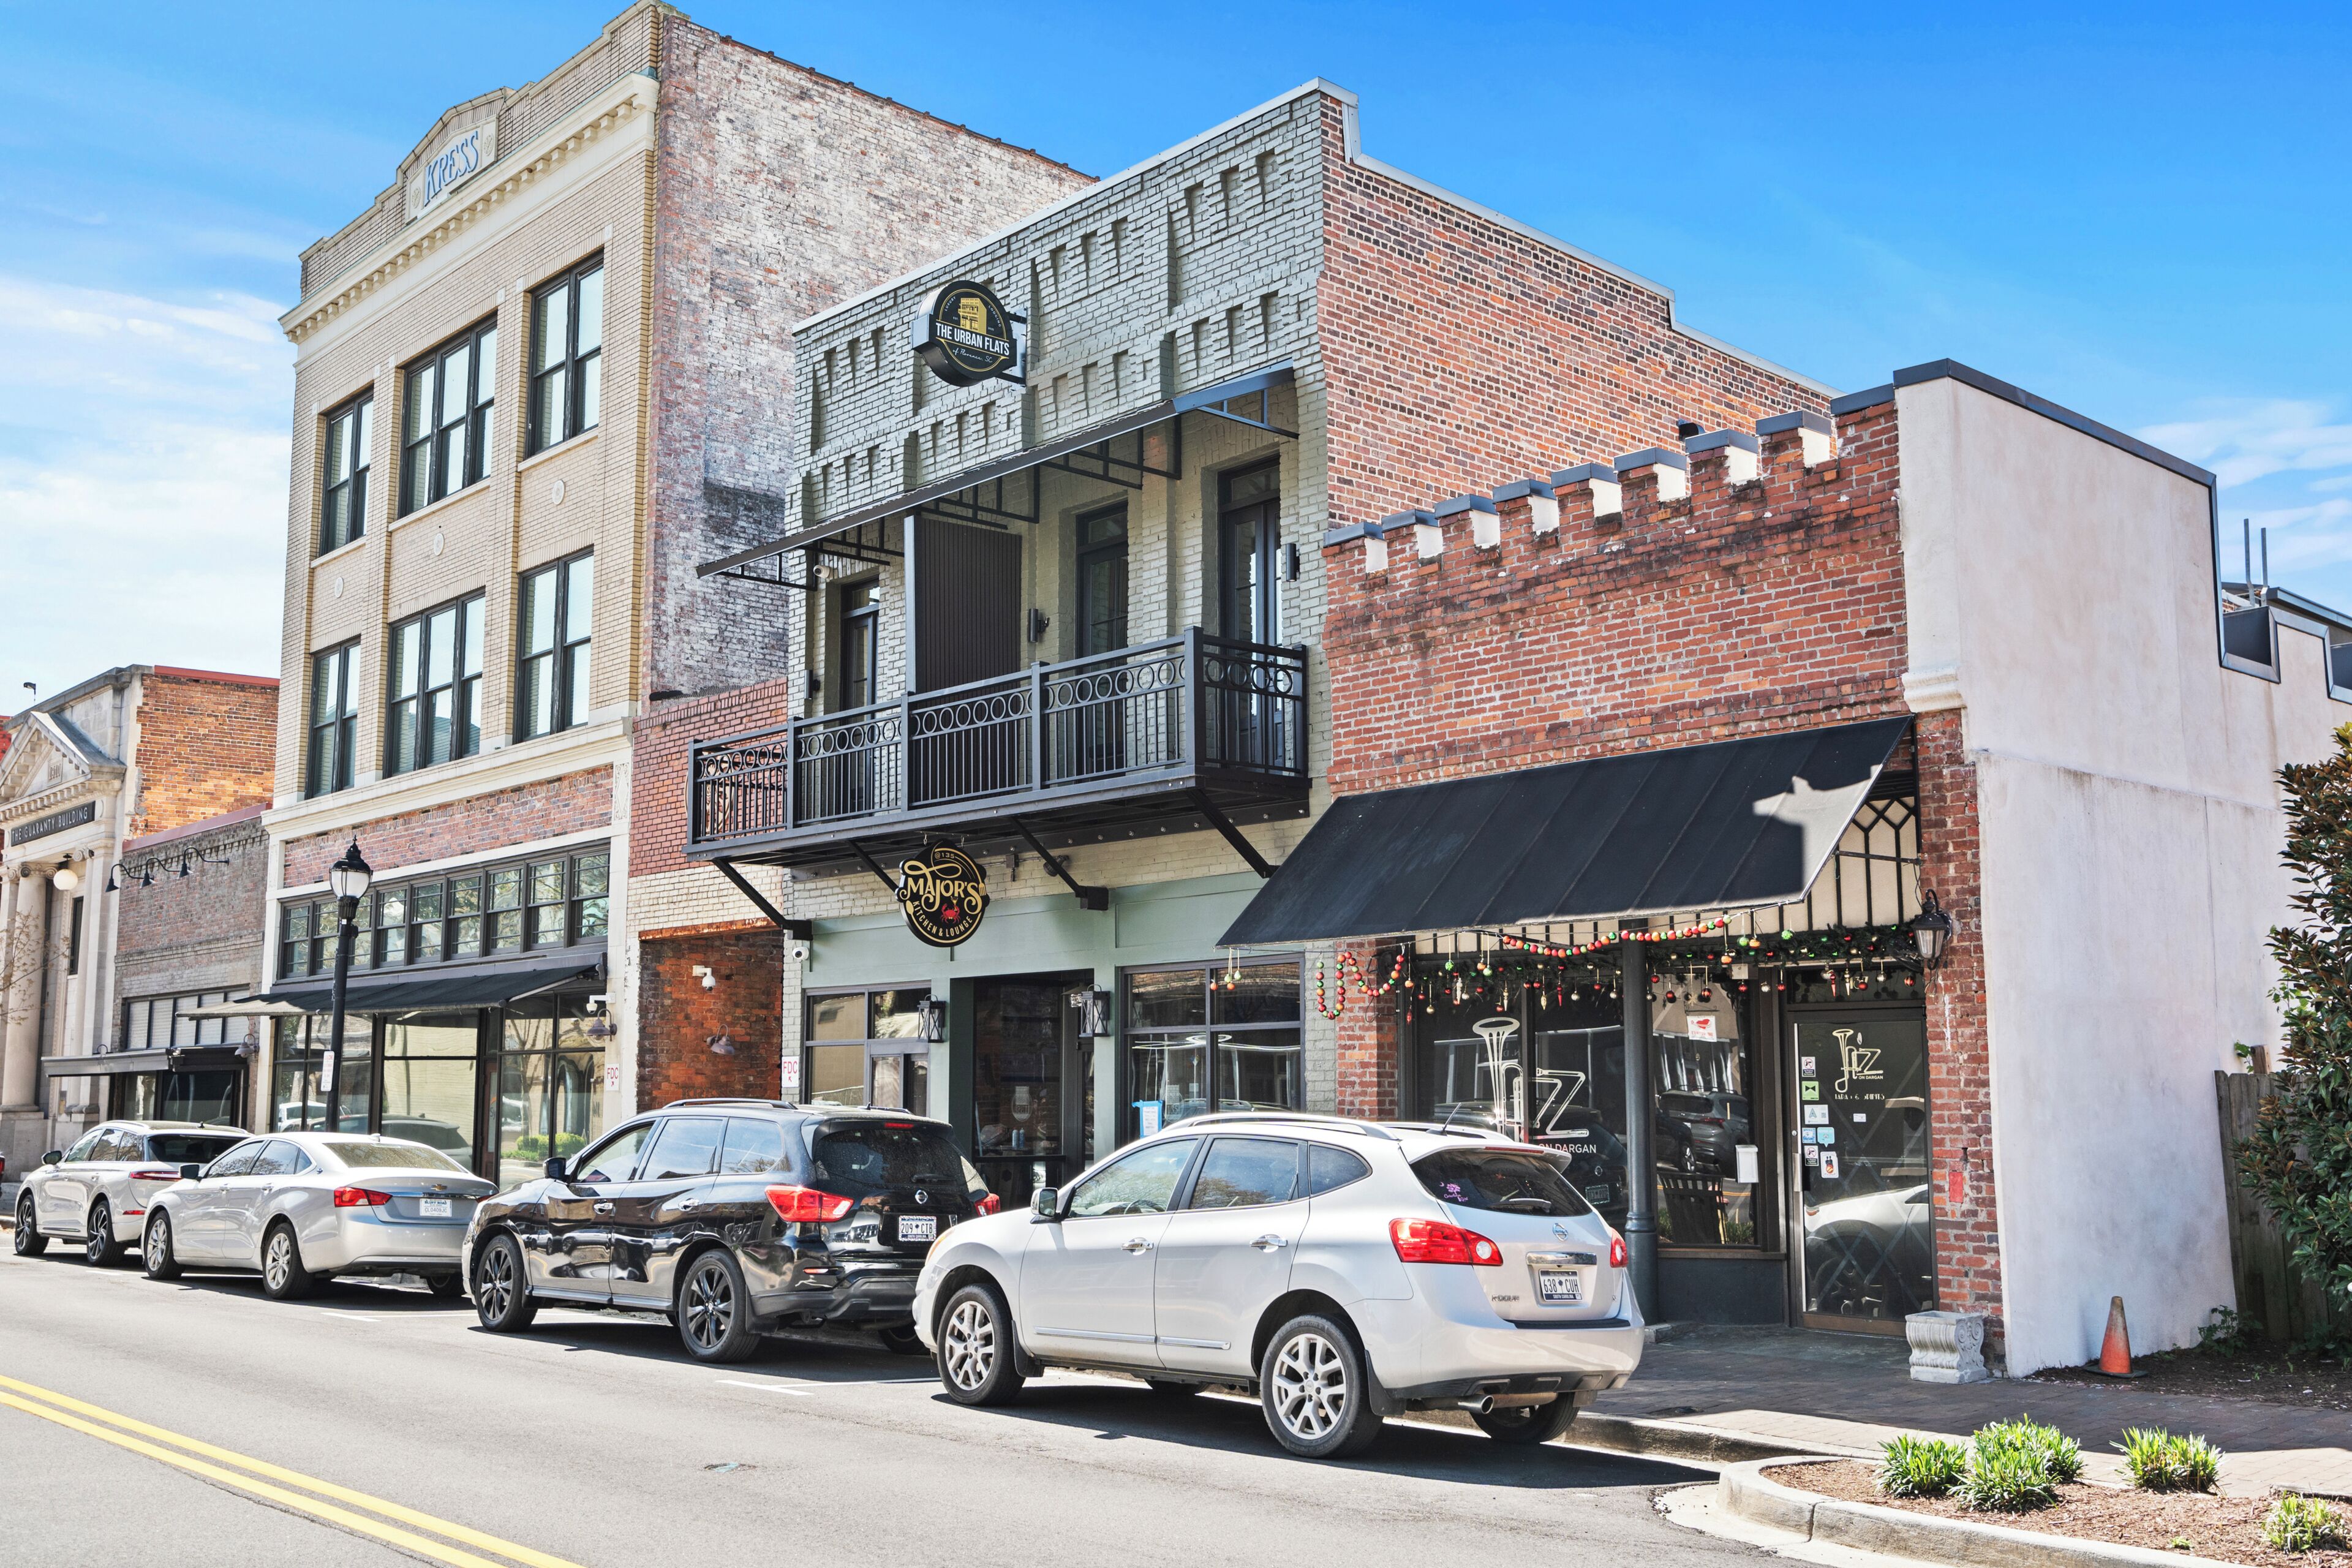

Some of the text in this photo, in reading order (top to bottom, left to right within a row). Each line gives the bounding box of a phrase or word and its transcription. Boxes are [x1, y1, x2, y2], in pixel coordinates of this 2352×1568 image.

[424, 130, 479, 207] KRESS
[944, 296, 956, 312] LUXURY
[987, 304, 1002, 328] LODGING
[935, 322, 1009, 356] THE URBAN FLATS
[12, 807, 88, 843] THE GUARANTY BUILDING
[899, 861, 983, 915] MAJOR'S
[913, 900, 937, 934] KITCHEN
[946, 915, 973, 937] LOUNGE
[607, 1068, 619, 1080] FDC
[783, 1061, 798, 1074] FDC
[1556, 1144, 1597, 1153] DARGAN
[901, 1223, 933, 1234] 209 CTB
[1544, 1279, 1579, 1292] 638 CUH
